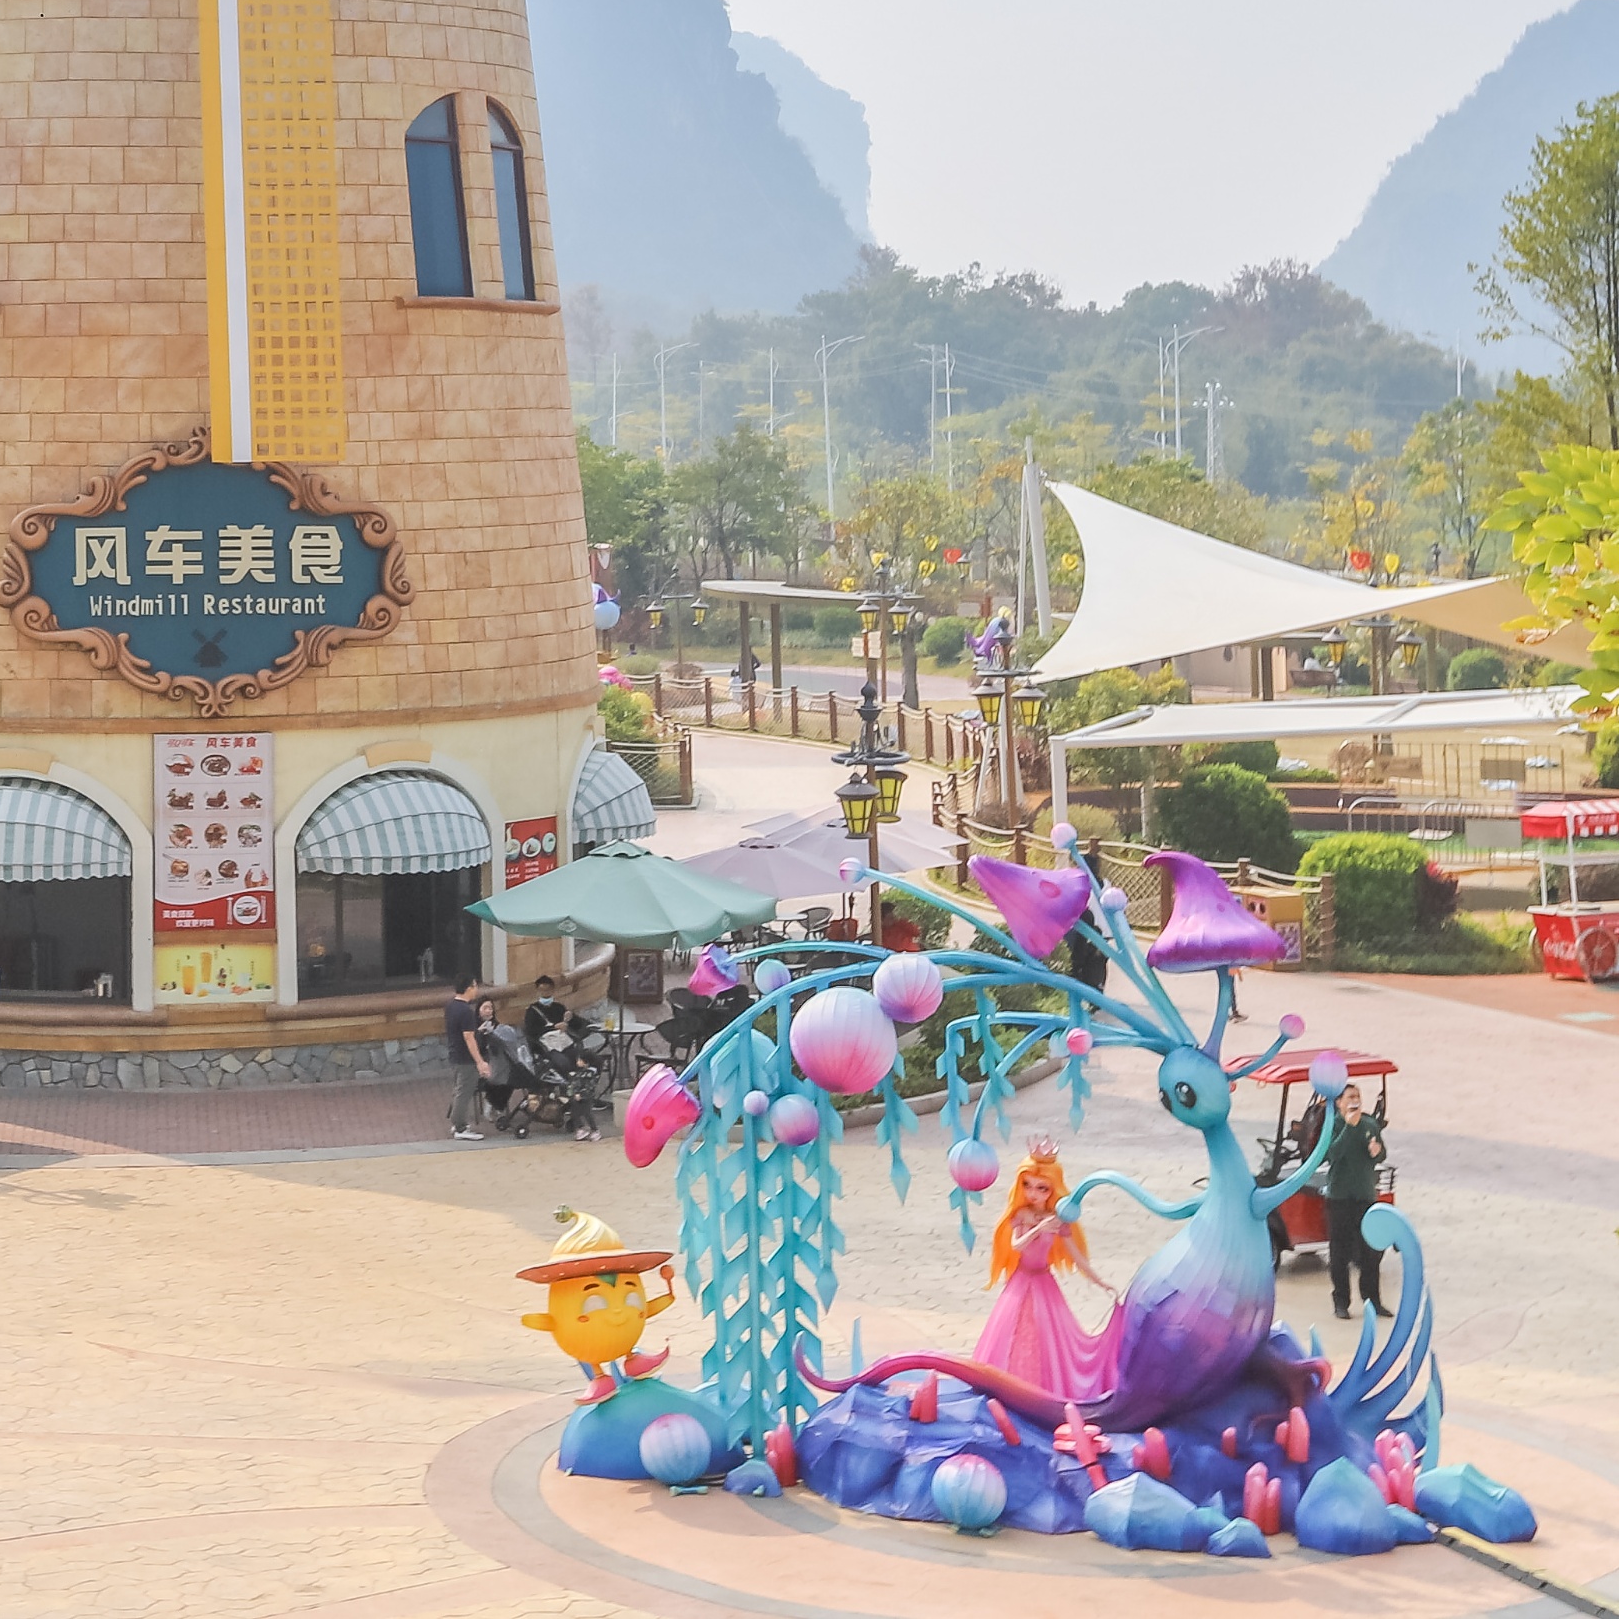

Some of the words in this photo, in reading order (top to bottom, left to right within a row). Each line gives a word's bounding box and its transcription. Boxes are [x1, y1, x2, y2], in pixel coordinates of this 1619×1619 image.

[72, 525, 344, 586] 风车美食
[90, 594, 190, 617] Windmill
[203, 594, 327, 617] Restaurant
[206, 736, 257, 748] 风车美食
